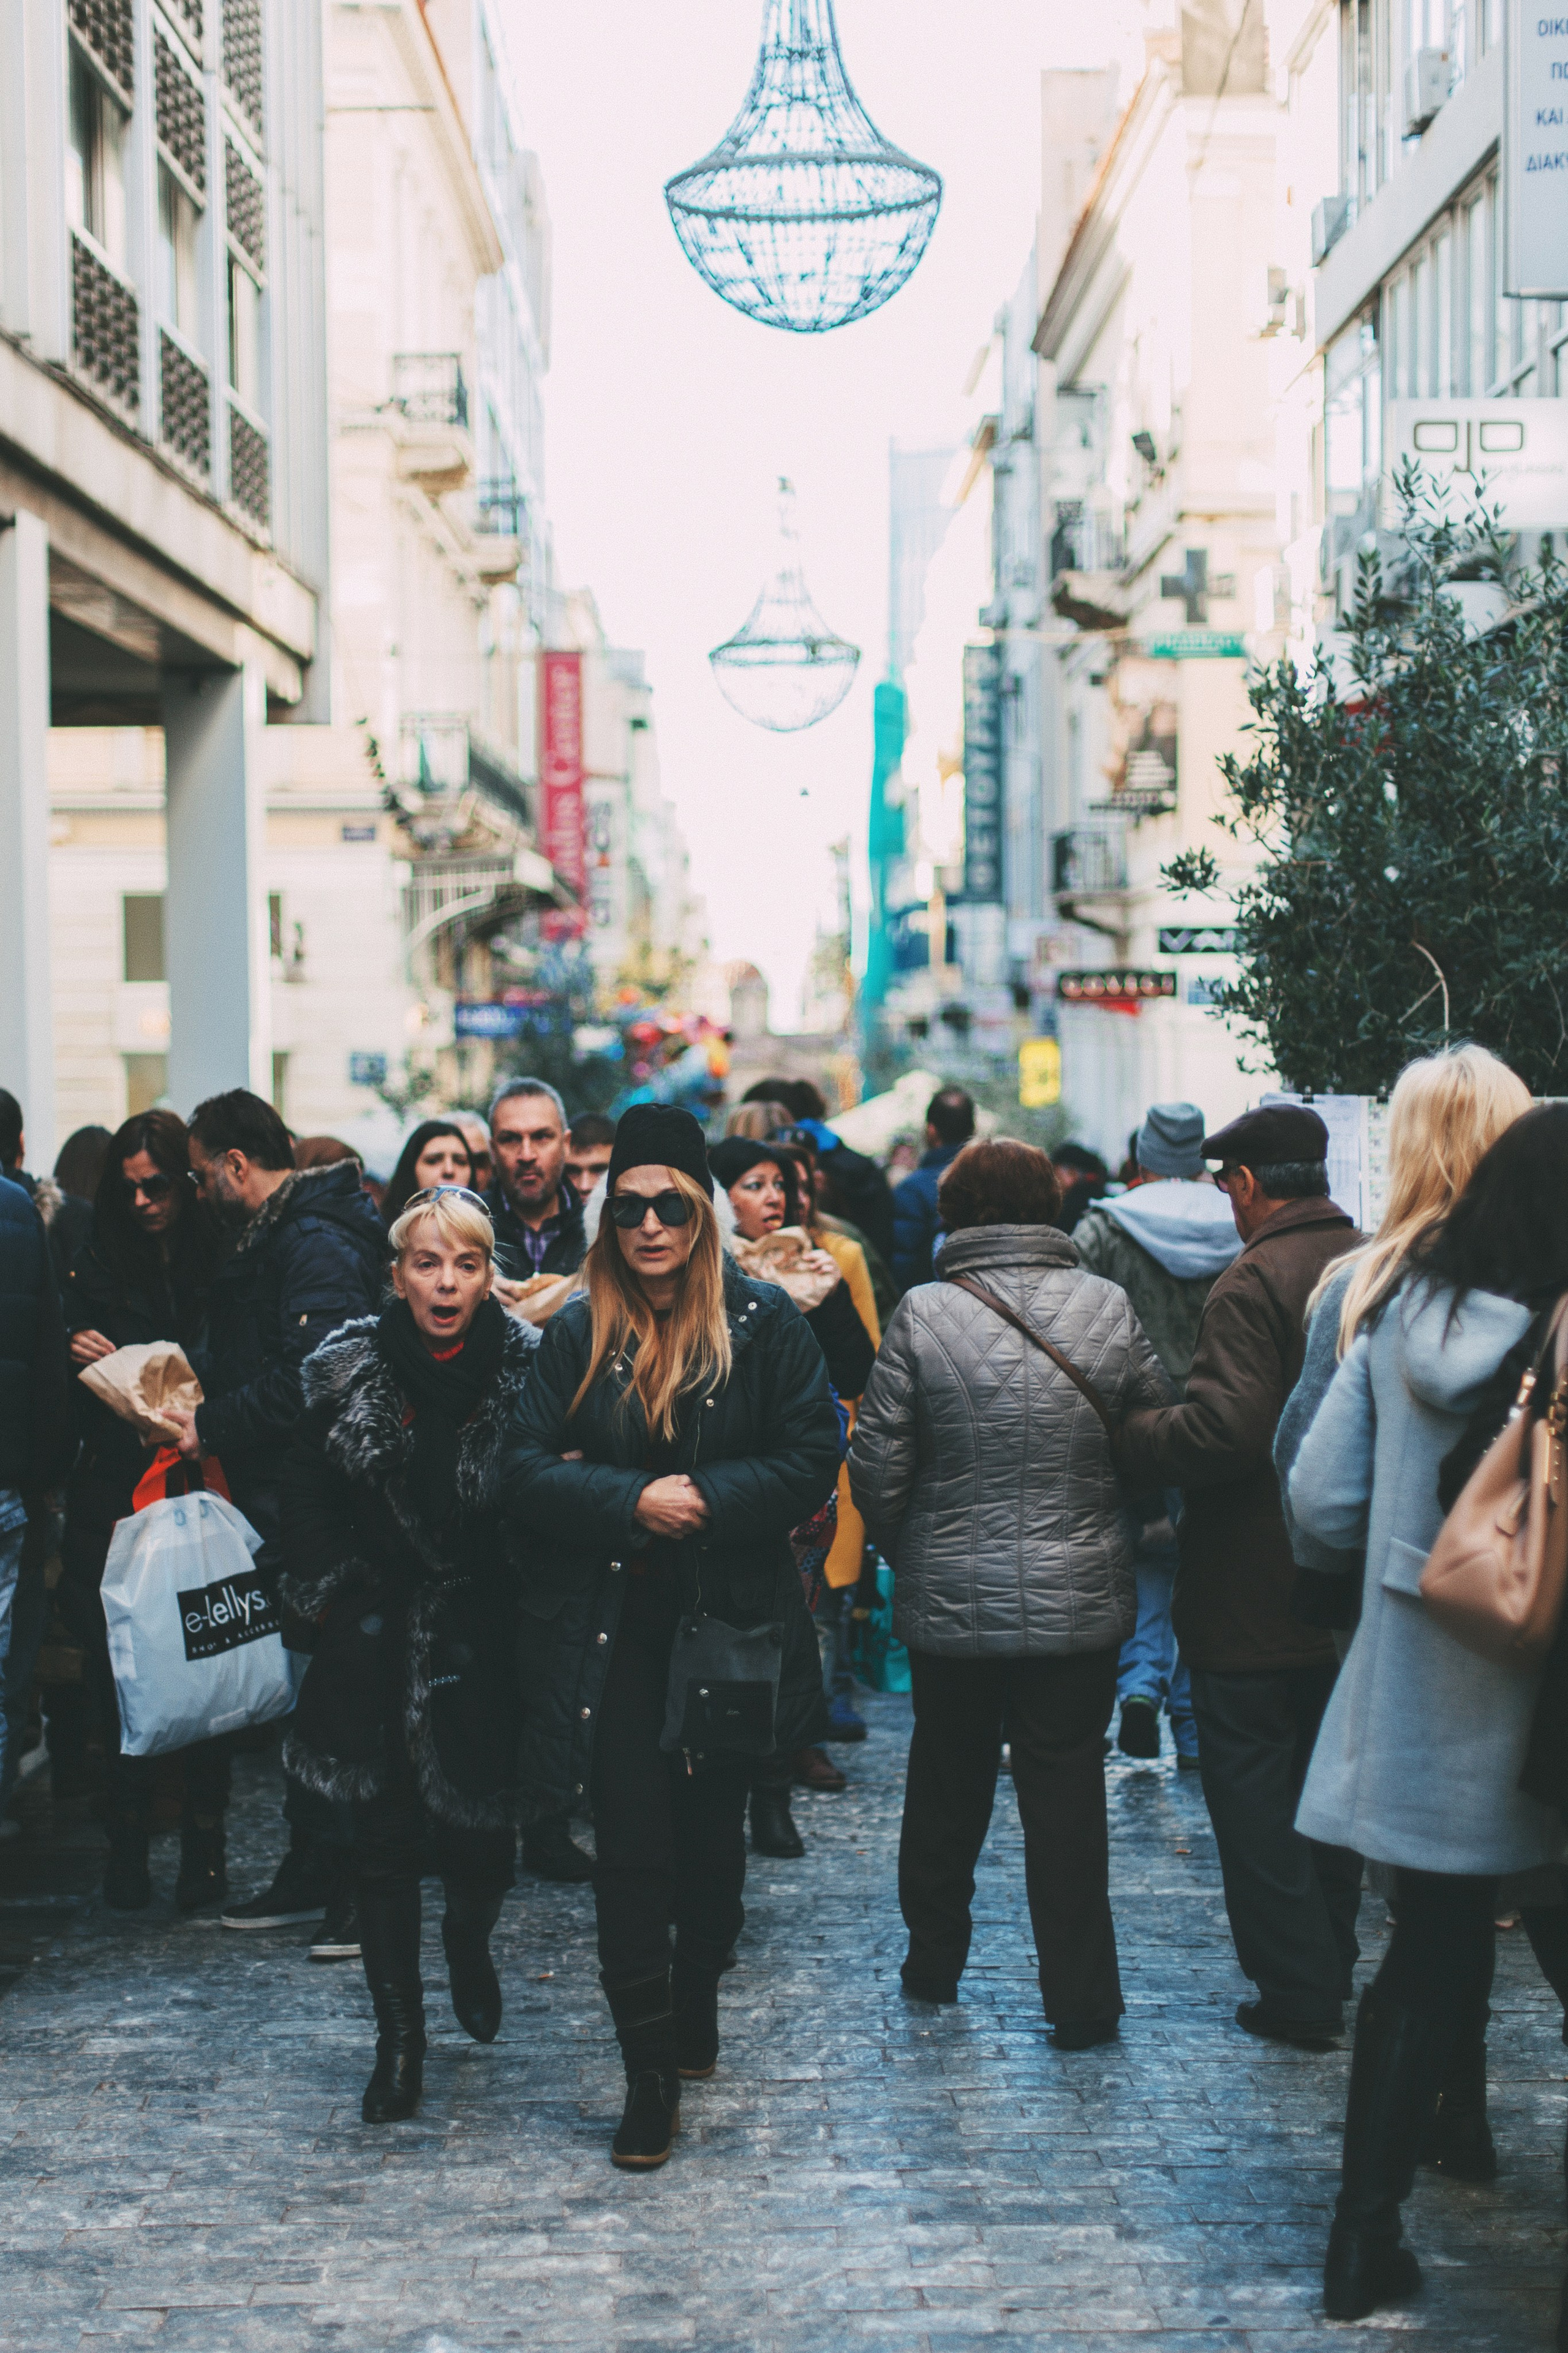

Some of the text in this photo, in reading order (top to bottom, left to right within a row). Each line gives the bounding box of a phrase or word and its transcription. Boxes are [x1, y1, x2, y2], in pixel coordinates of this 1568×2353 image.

[1538, 18, 1568, 36] ΟΙΚ
[1536, 107, 1563, 126] ΚΑΙ
[1526, 151, 1568, 172] ΔΙΑΚ
